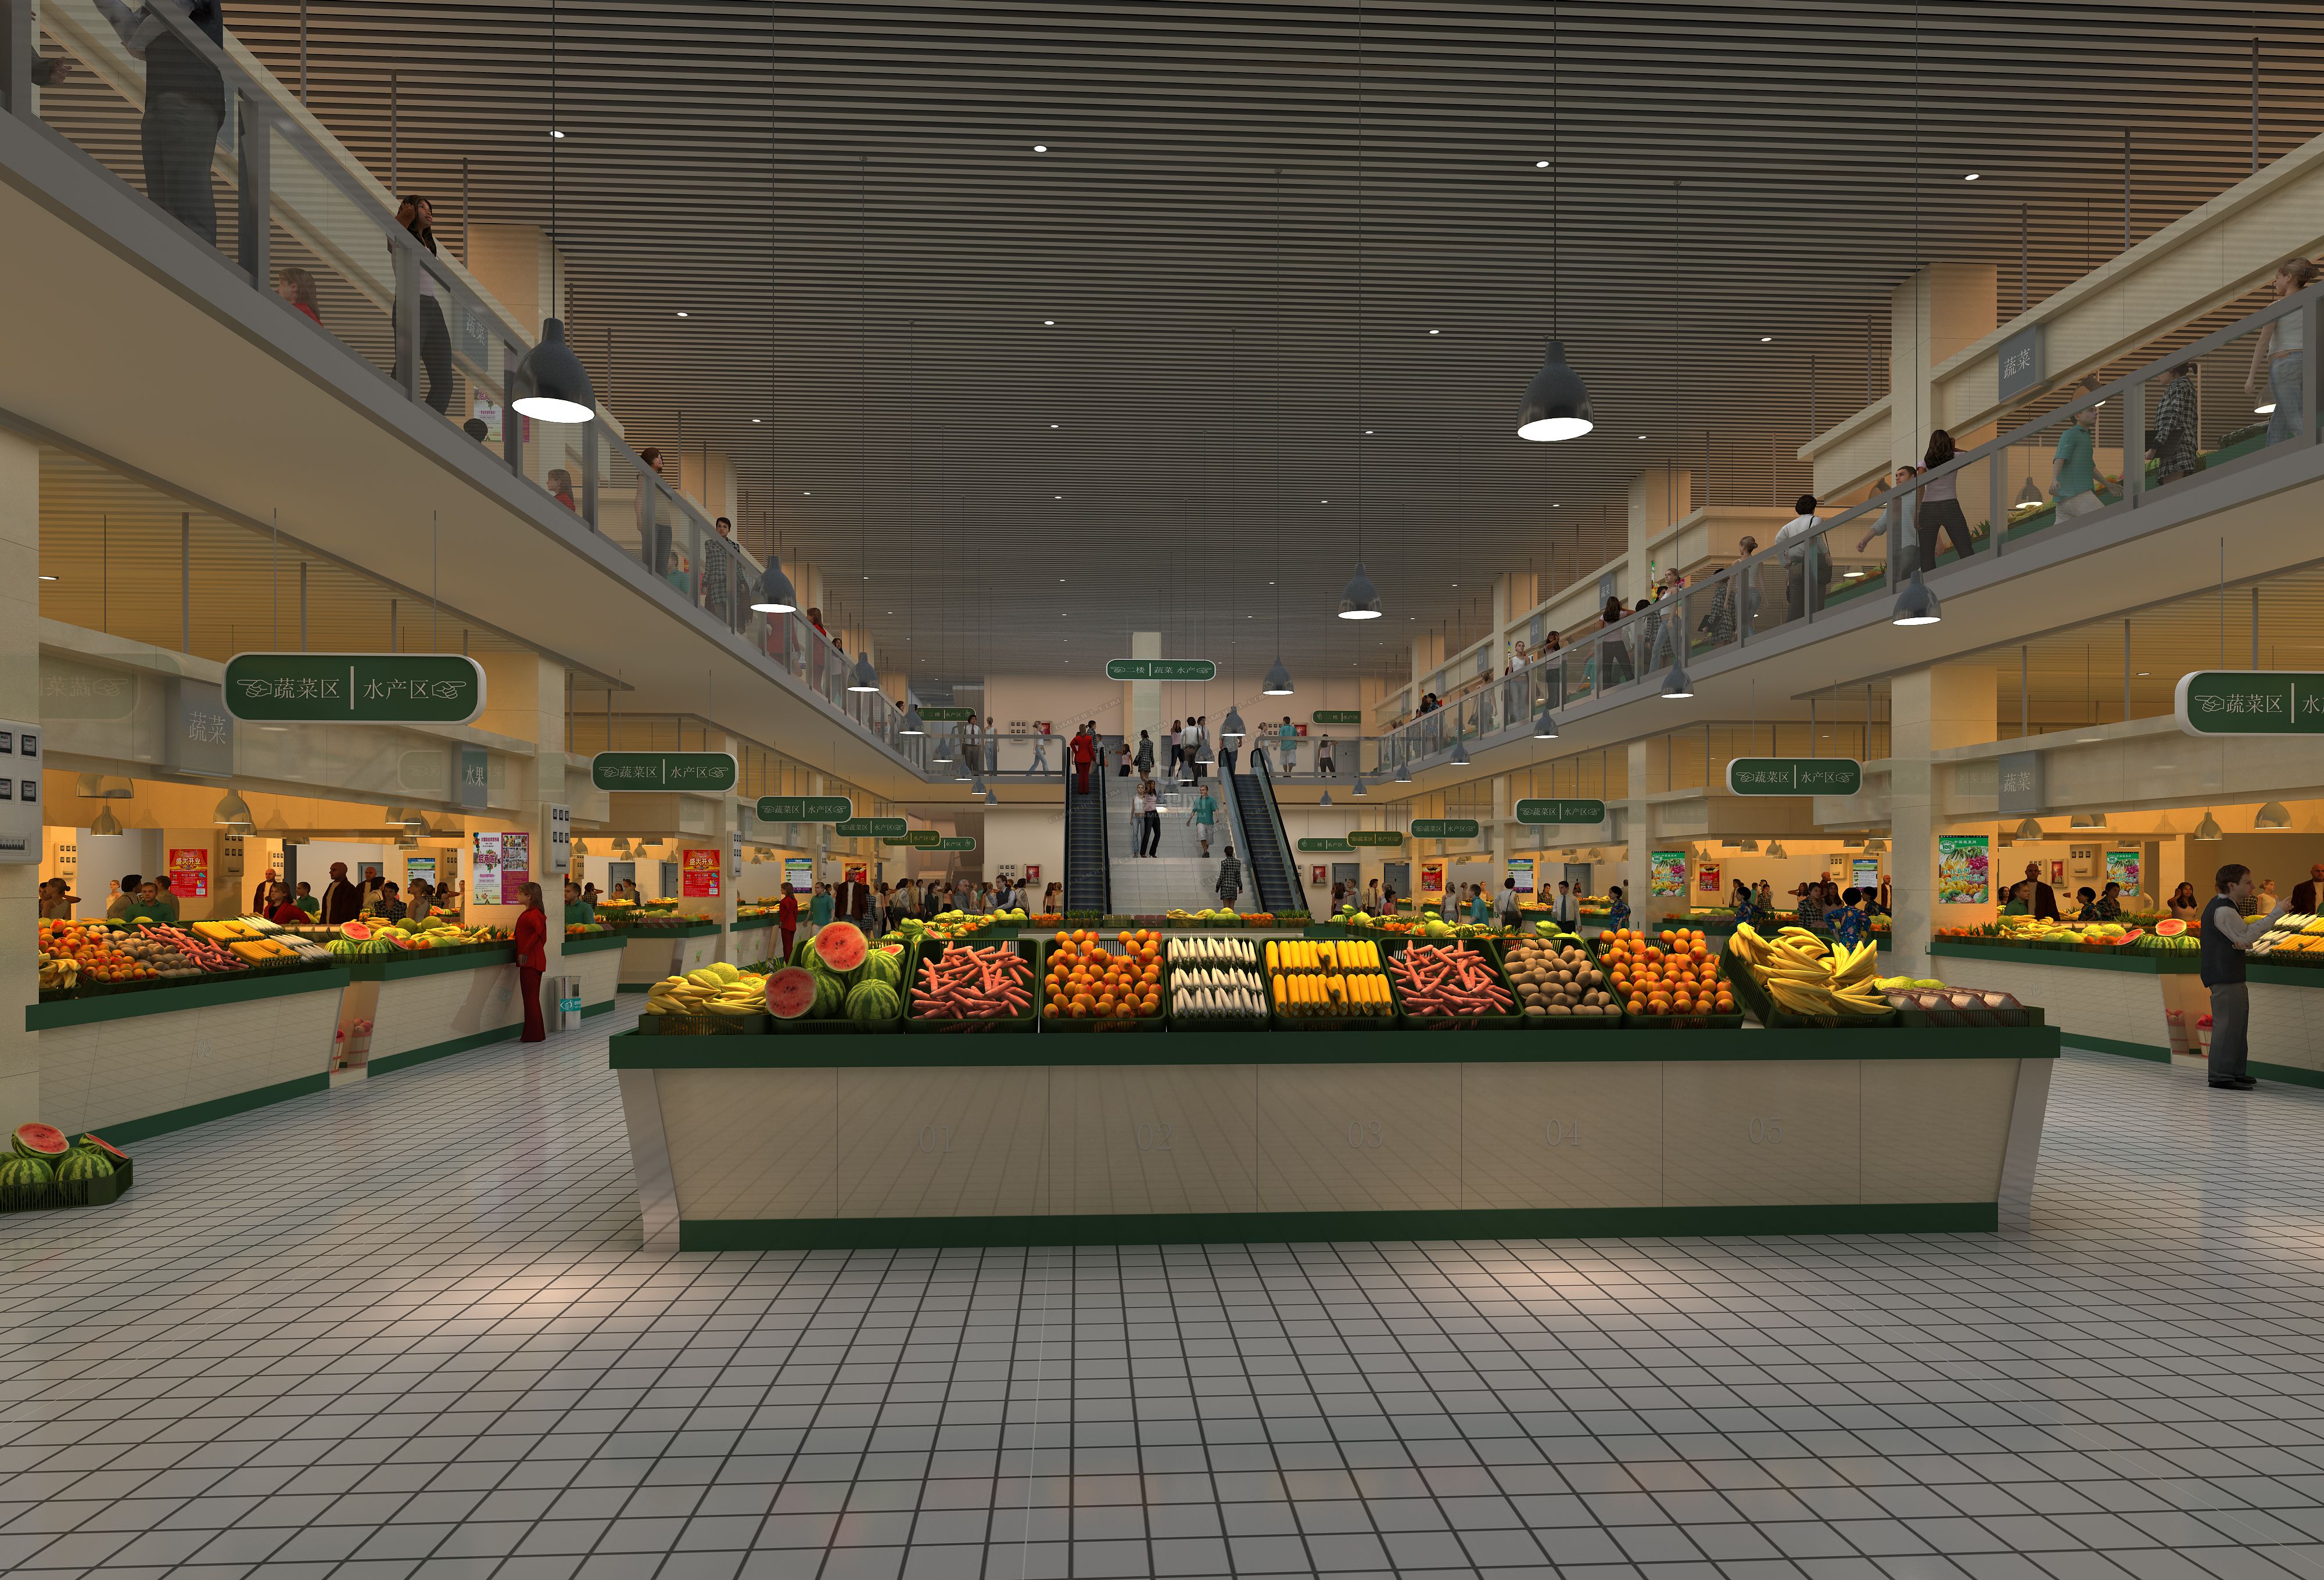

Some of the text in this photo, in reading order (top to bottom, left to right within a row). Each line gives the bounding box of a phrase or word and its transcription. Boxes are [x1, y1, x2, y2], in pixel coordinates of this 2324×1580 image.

[465, 313, 485, 346] 蔬菜
[2004, 349, 2030, 379] 蔬菜
[274, 677, 430, 700] 蔬菜区 水产区
[2226, 694, 2324, 714] 蔬菜区 水
[188, 710, 227, 745] 蔬菜
[465, 764, 484, 787] 水果
[619, 766, 707, 778] 蔬菜区 水产区
[1755, 771, 1835, 783] 蔬菜区 水产区
[2004, 771, 2031, 793] 蔬菜
[775, 805, 833, 814] 蔬菜区 水产区
[1533, 807, 1588, 816] 蔬菜区 水产区
[175, 857, 202, 866] 盛大开业
[919, 1125, 953, 1152] 01
[1136, 1123, 1172, 1151] 02
[1347, 1121, 1382, 1148] 03
[1546, 1119, 1580, 1147] 04
[1748, 1115, 1783, 1144] 05
